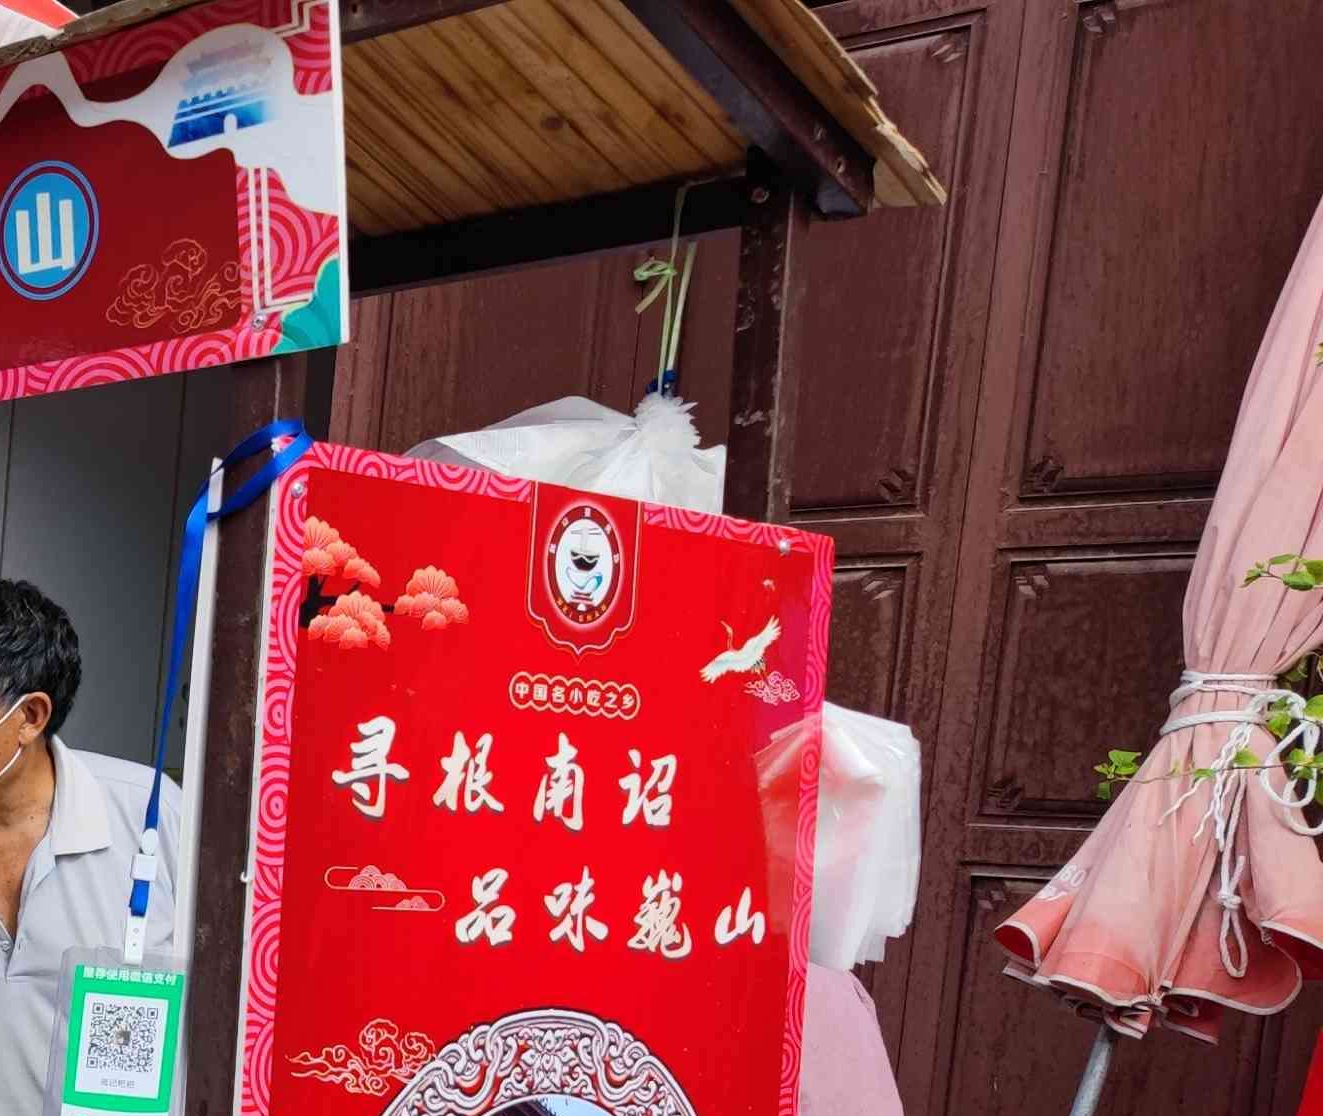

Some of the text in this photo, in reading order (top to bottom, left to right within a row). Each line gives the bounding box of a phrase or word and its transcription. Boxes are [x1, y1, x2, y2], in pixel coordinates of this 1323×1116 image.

[514, 681, 635, 710] 中国名小吃之乡
[332, 715, 677, 832] 寻根南诏
[454, 866, 767, 960] 品味巍山
